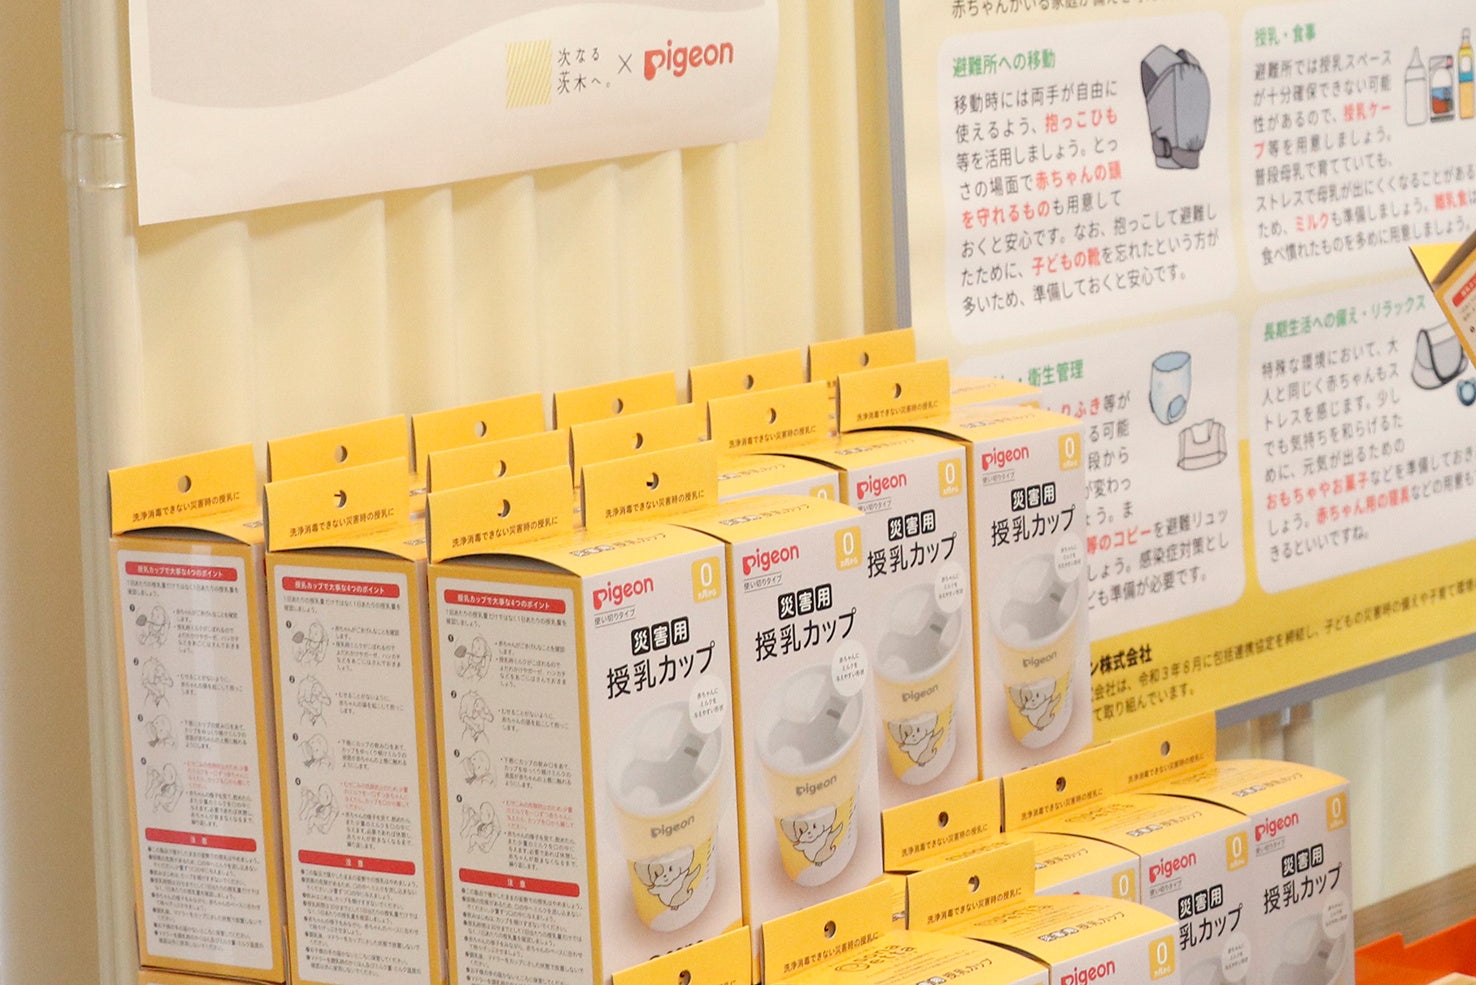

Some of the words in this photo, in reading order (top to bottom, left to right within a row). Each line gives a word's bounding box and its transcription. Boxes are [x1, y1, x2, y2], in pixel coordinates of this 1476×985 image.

[953, 48, 1055, 78] 避難所への移動
[954, 80, 1117, 115] 移動時には両手が自由に
[956, 108, 1118, 144] 使えるよう、抱っこひも
[962, 189, 1122, 230] を守れるものも用意して
[1011, 482, 1056, 511] 災害用
[888, 509, 936, 541] 災害用
[992, 504, 1076, 548] 授乳カップ
[867, 531, 957, 579] 授乳カップ
[779, 584, 832, 620] 災害用
[632, 618, 689, 655] 災害用
[755, 607, 857, 662] 授乳カップ
[607, 640, 715, 700] 授乳カップ
[1282, 843, 1324, 878] 災害用
[1178, 884, 1223, 920] 災害用
[1264, 862, 1342, 915] 授乳カップ
